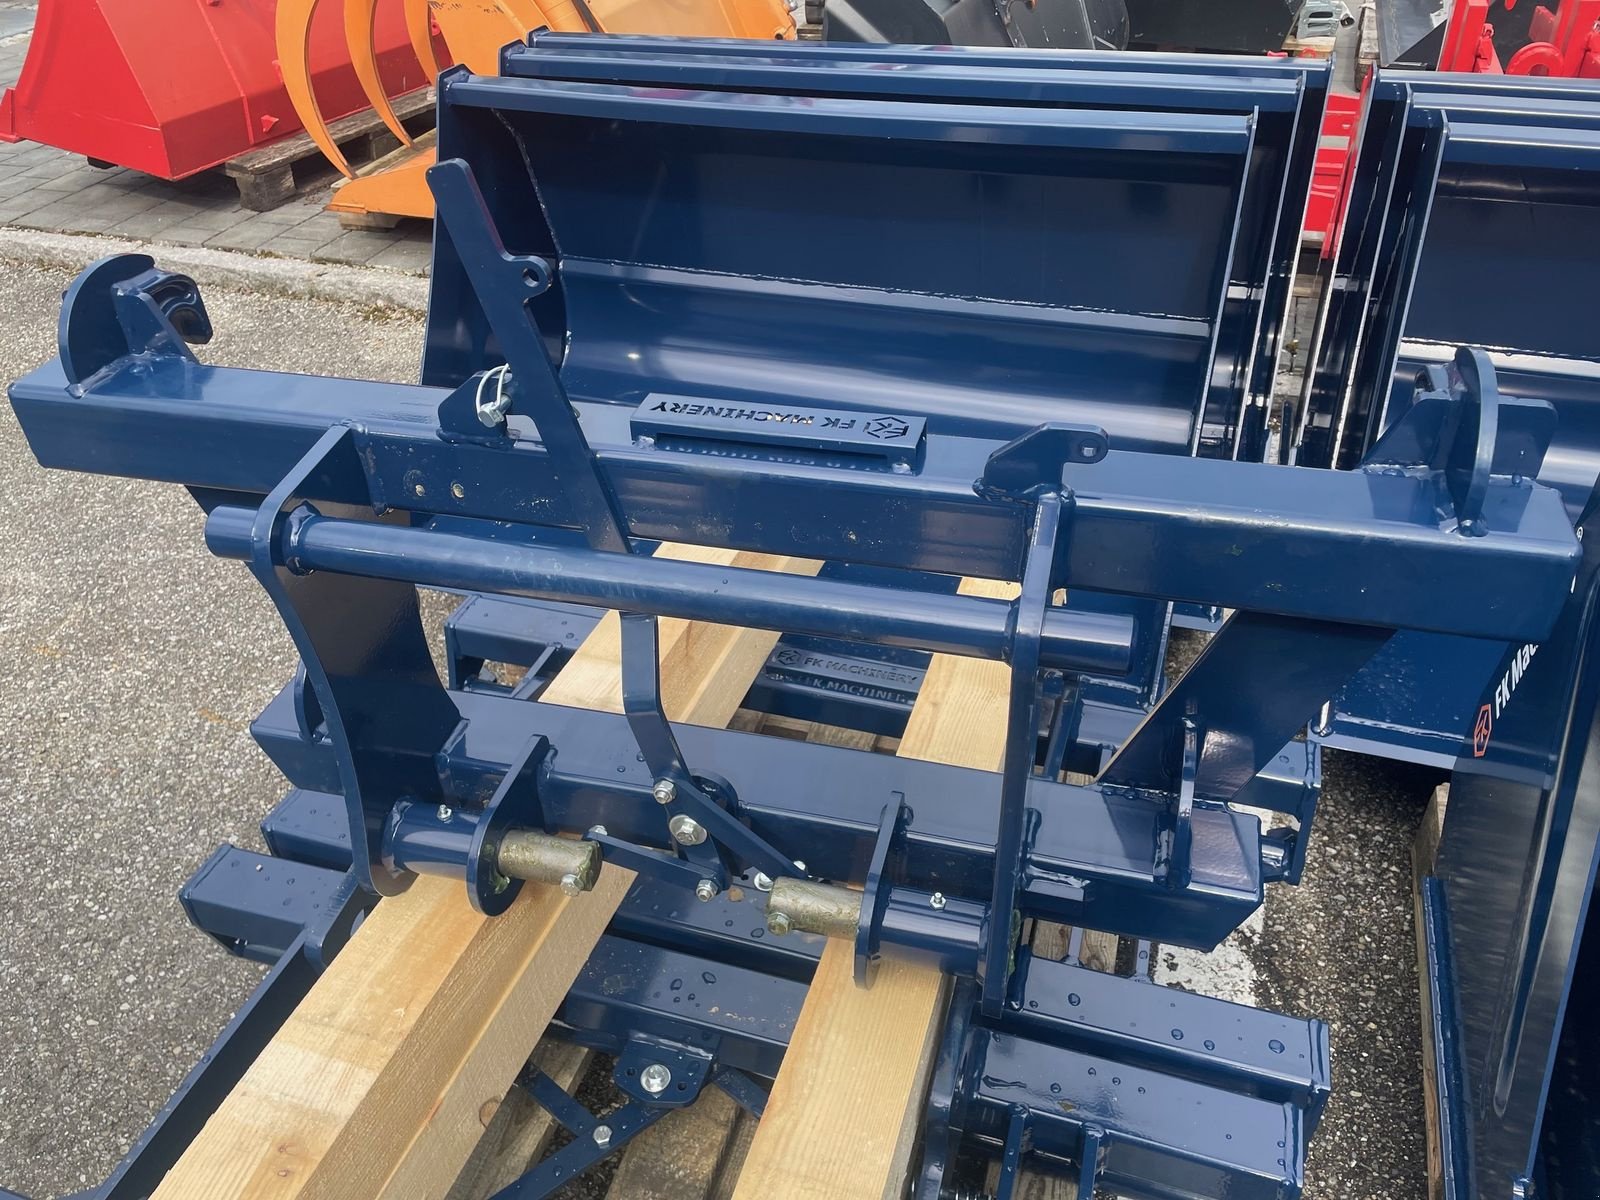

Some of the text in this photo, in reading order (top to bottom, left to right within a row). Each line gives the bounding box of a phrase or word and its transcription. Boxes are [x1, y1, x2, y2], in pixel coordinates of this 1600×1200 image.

[650, 401, 857, 430] FK MACHINERY
[803, 656, 919, 685] FK MACHINERY
[1495, 670, 1510, 719] FK
